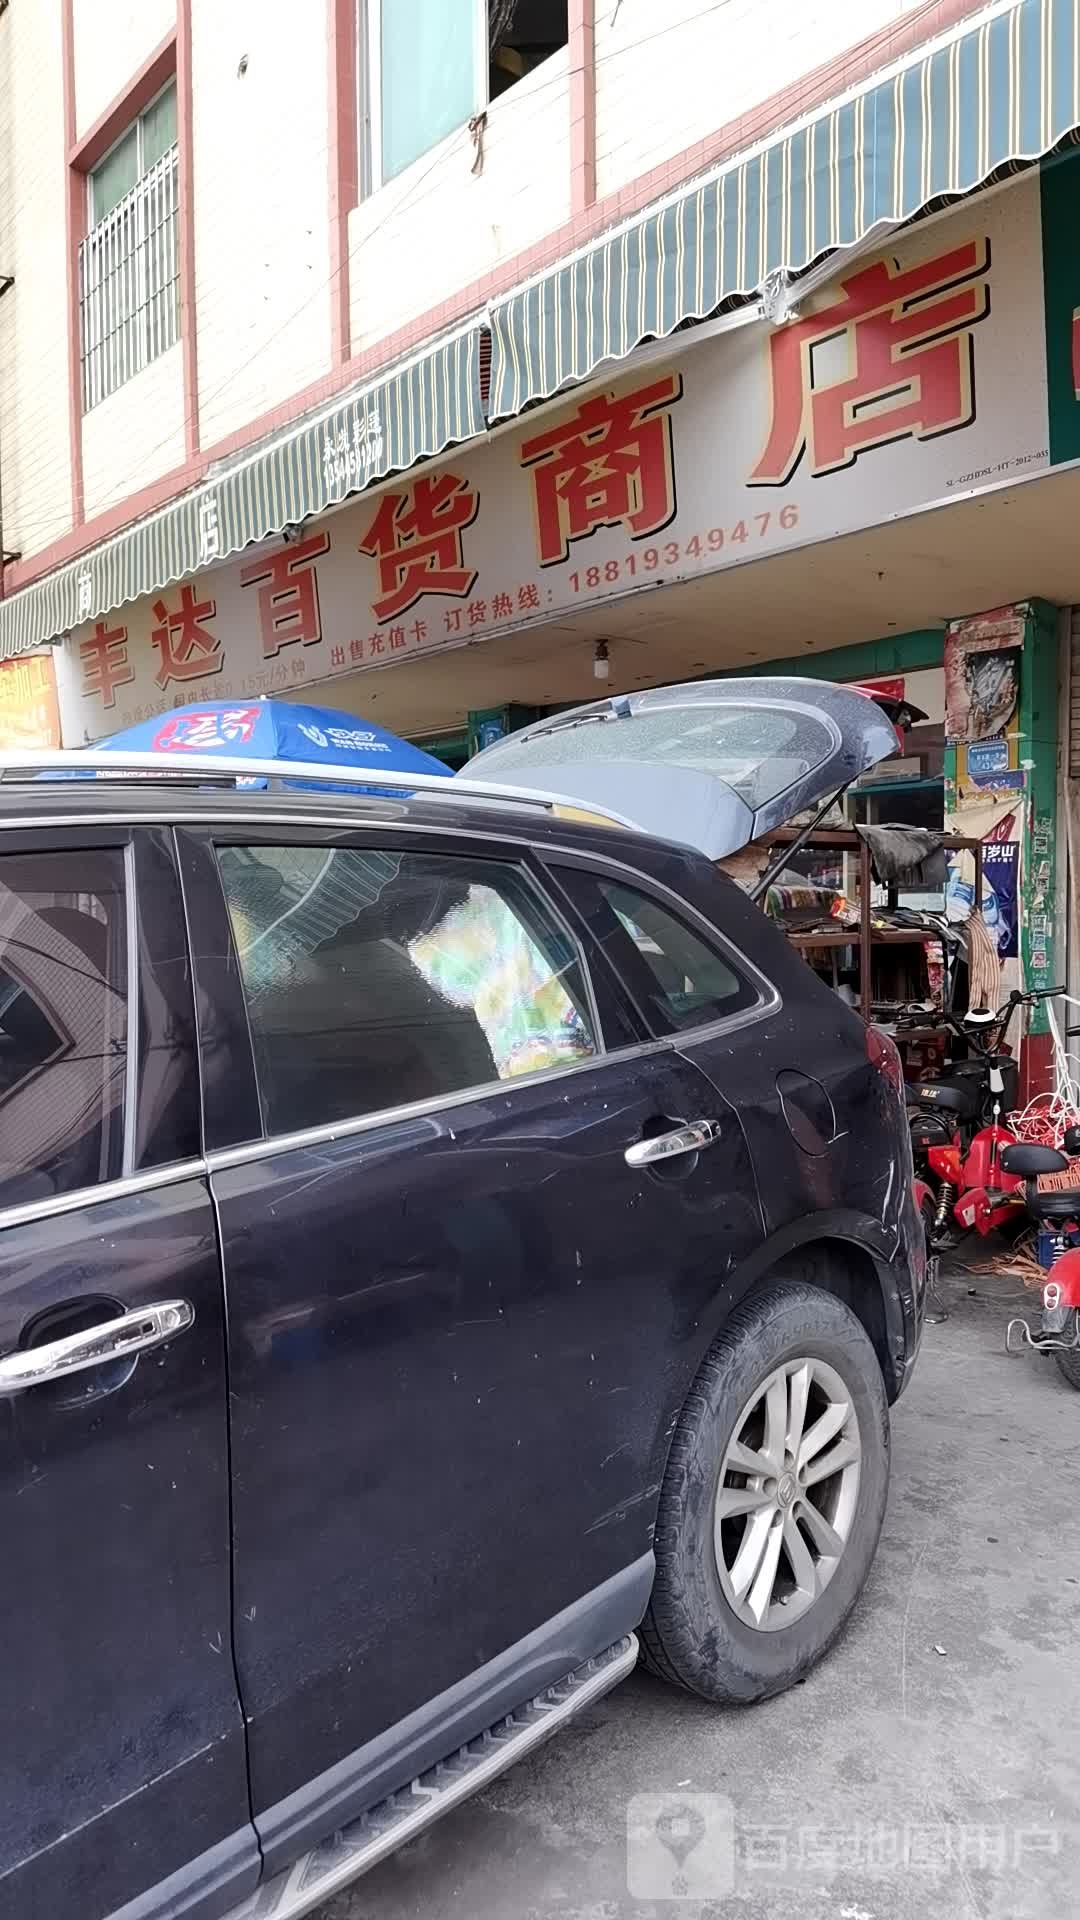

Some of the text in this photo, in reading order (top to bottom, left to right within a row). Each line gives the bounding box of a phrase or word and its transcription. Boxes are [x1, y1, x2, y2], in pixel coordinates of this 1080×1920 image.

[78, 236, 991, 709] 丰达百货商店
[199, 494, 219, 560] 店
[330, 620, 430, 667] 出售充值卡
